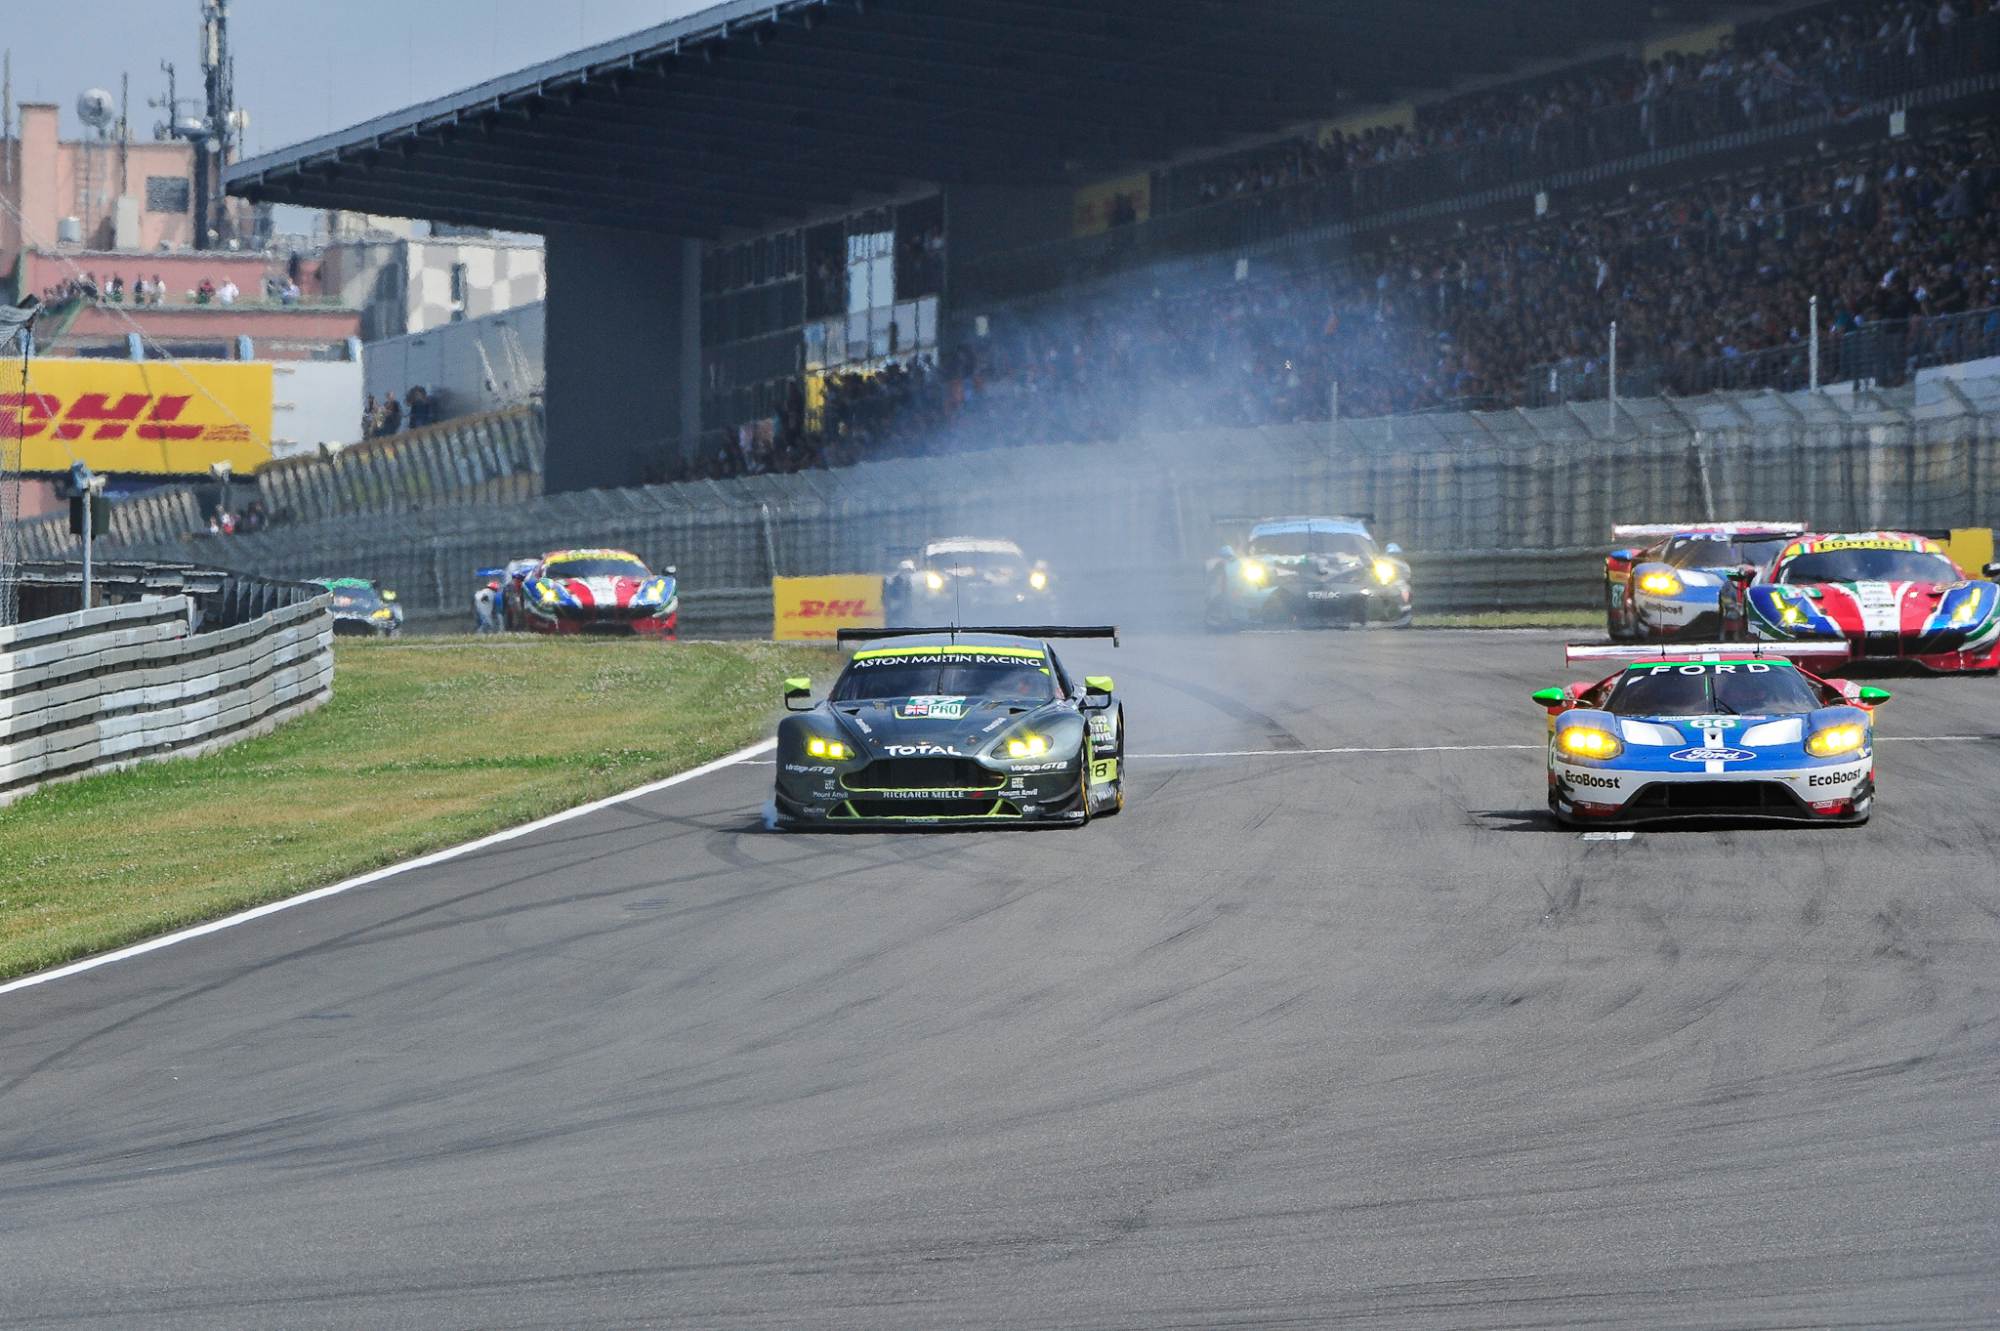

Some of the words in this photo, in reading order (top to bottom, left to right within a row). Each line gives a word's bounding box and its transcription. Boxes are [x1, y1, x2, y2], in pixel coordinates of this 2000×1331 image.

[0, 393, 204, 440] DHL
[800, 599, 873, 617] DHL
[854, 655, 908, 669] ASTON
[911, 653, 973, 664] MARTIN
[976, 654, 1041, 667] RACING
[1650, 663, 1770, 676] FORD
[930, 705, 958, 715] PRO
[1690, 719, 1736, 729] 66
[884, 745, 962, 756] TOTAL
[1686, 748, 1740, 760] Ford
[1565, 769, 1621, 789] EcoBoost
[1809, 768, 1861, 787] EcoBoost
[883, 791, 928, 799] RICHARD
[931, 791, 964, 799] MILLE
